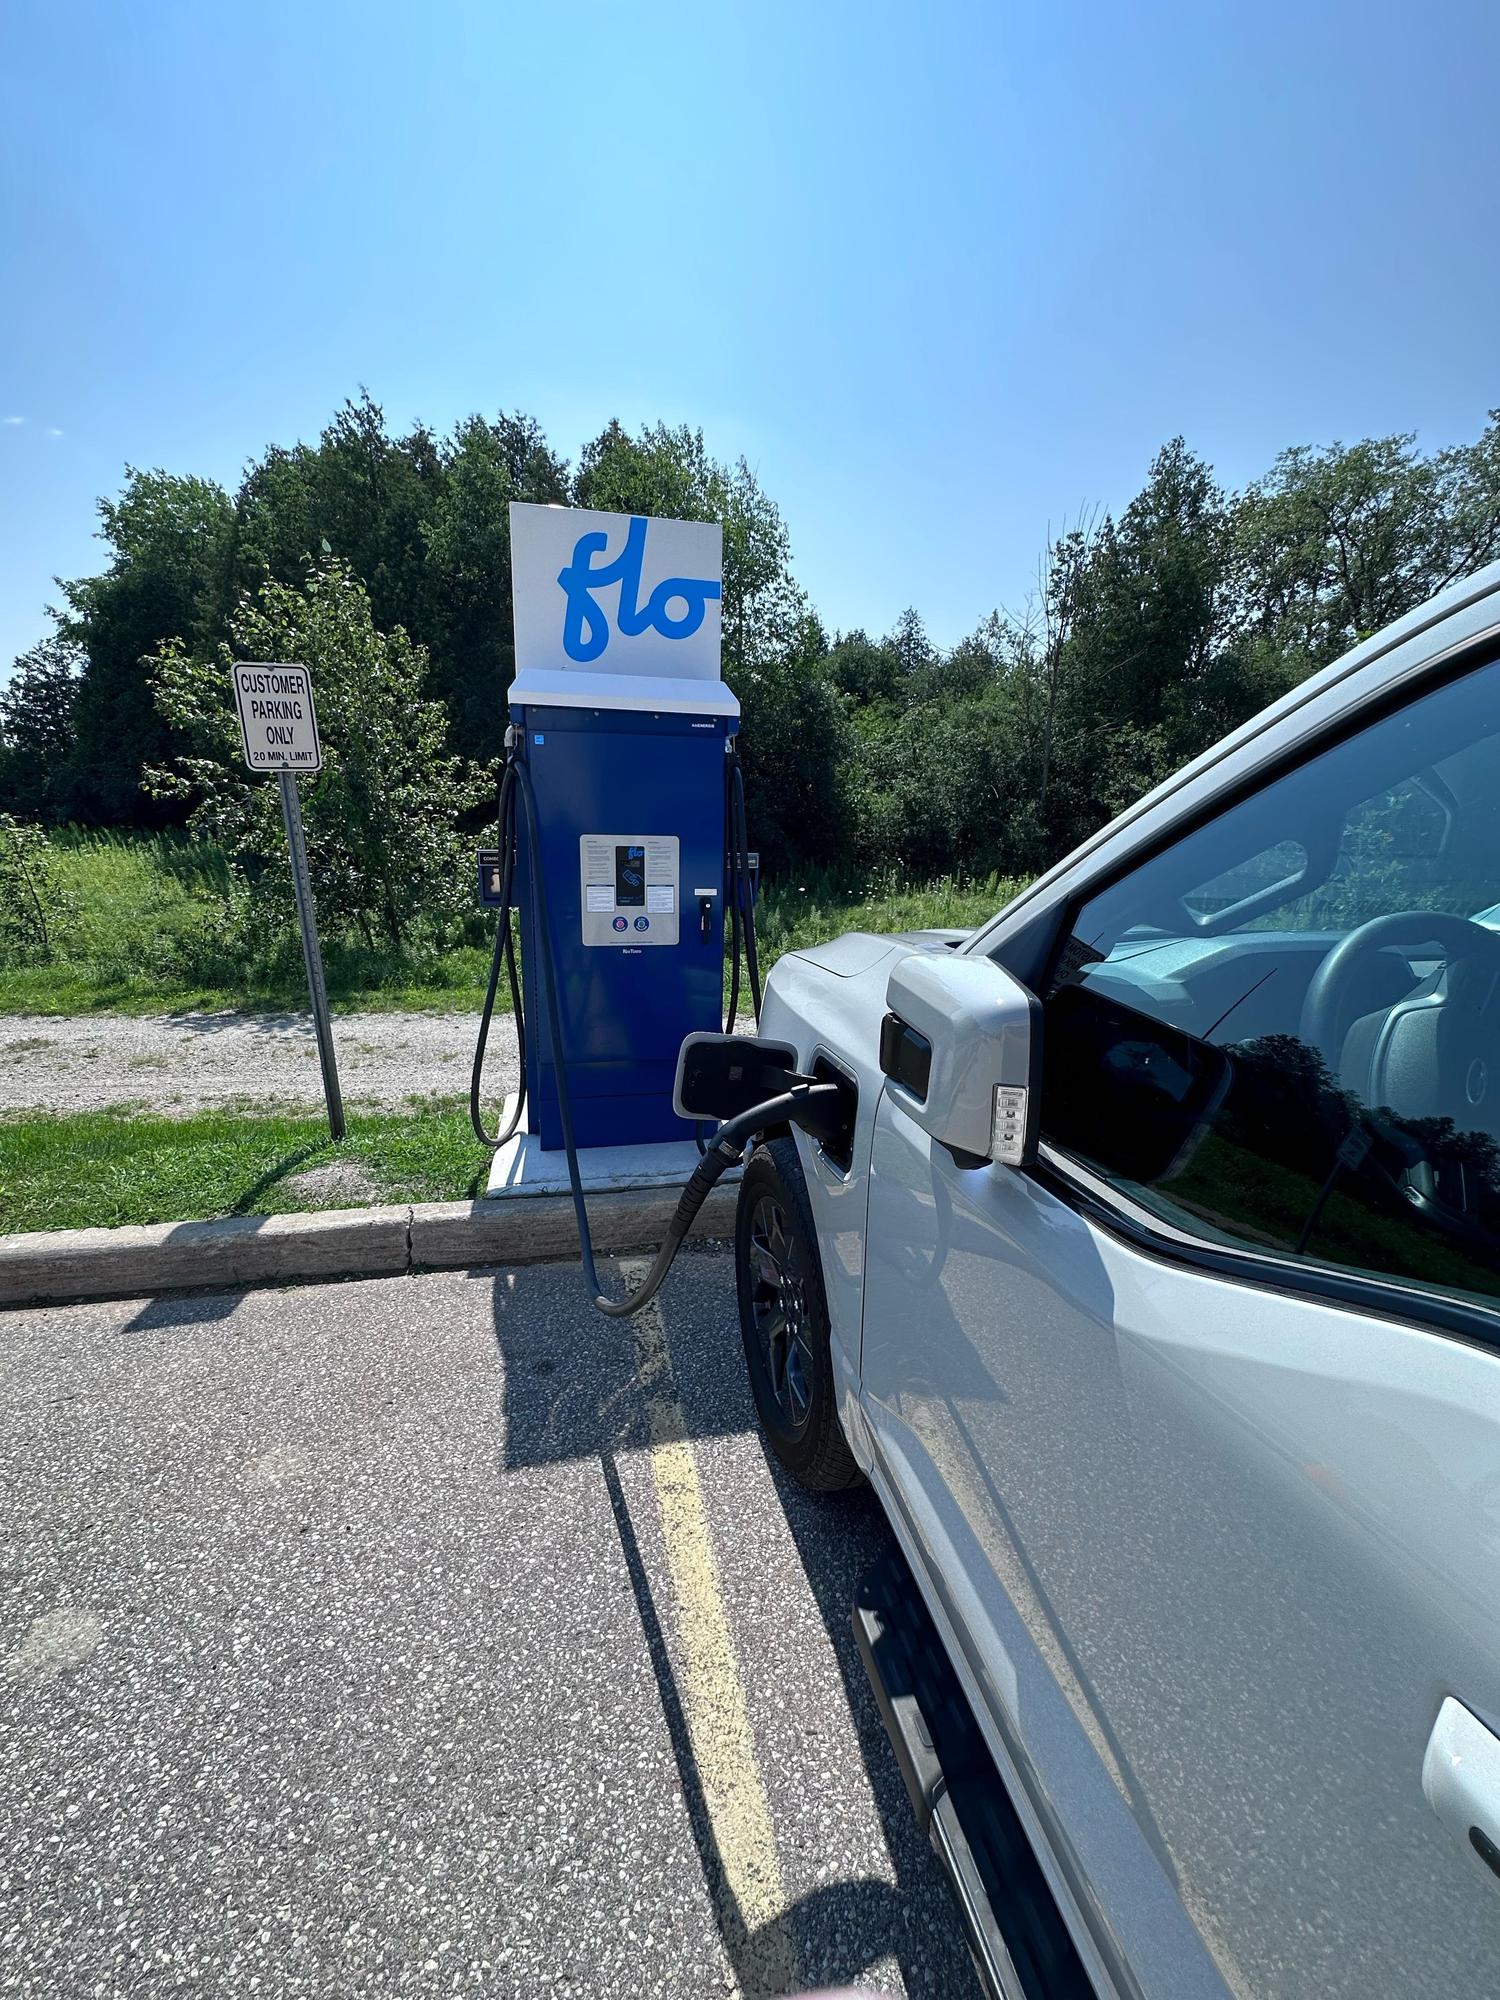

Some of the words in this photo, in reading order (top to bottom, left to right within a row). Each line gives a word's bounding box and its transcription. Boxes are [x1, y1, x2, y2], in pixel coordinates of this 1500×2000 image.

[557, 517, 721, 663] flo
[241, 673, 305, 694] CUSTOMER
[251, 700, 303, 720] PARKING
[266, 726, 294, 745] ONLY
[253, 751, 266, 761] 20
[268, 751, 289, 761] MIN.
[289, 751, 313, 761] LIMIT
[627, 847, 645, 860] flo
